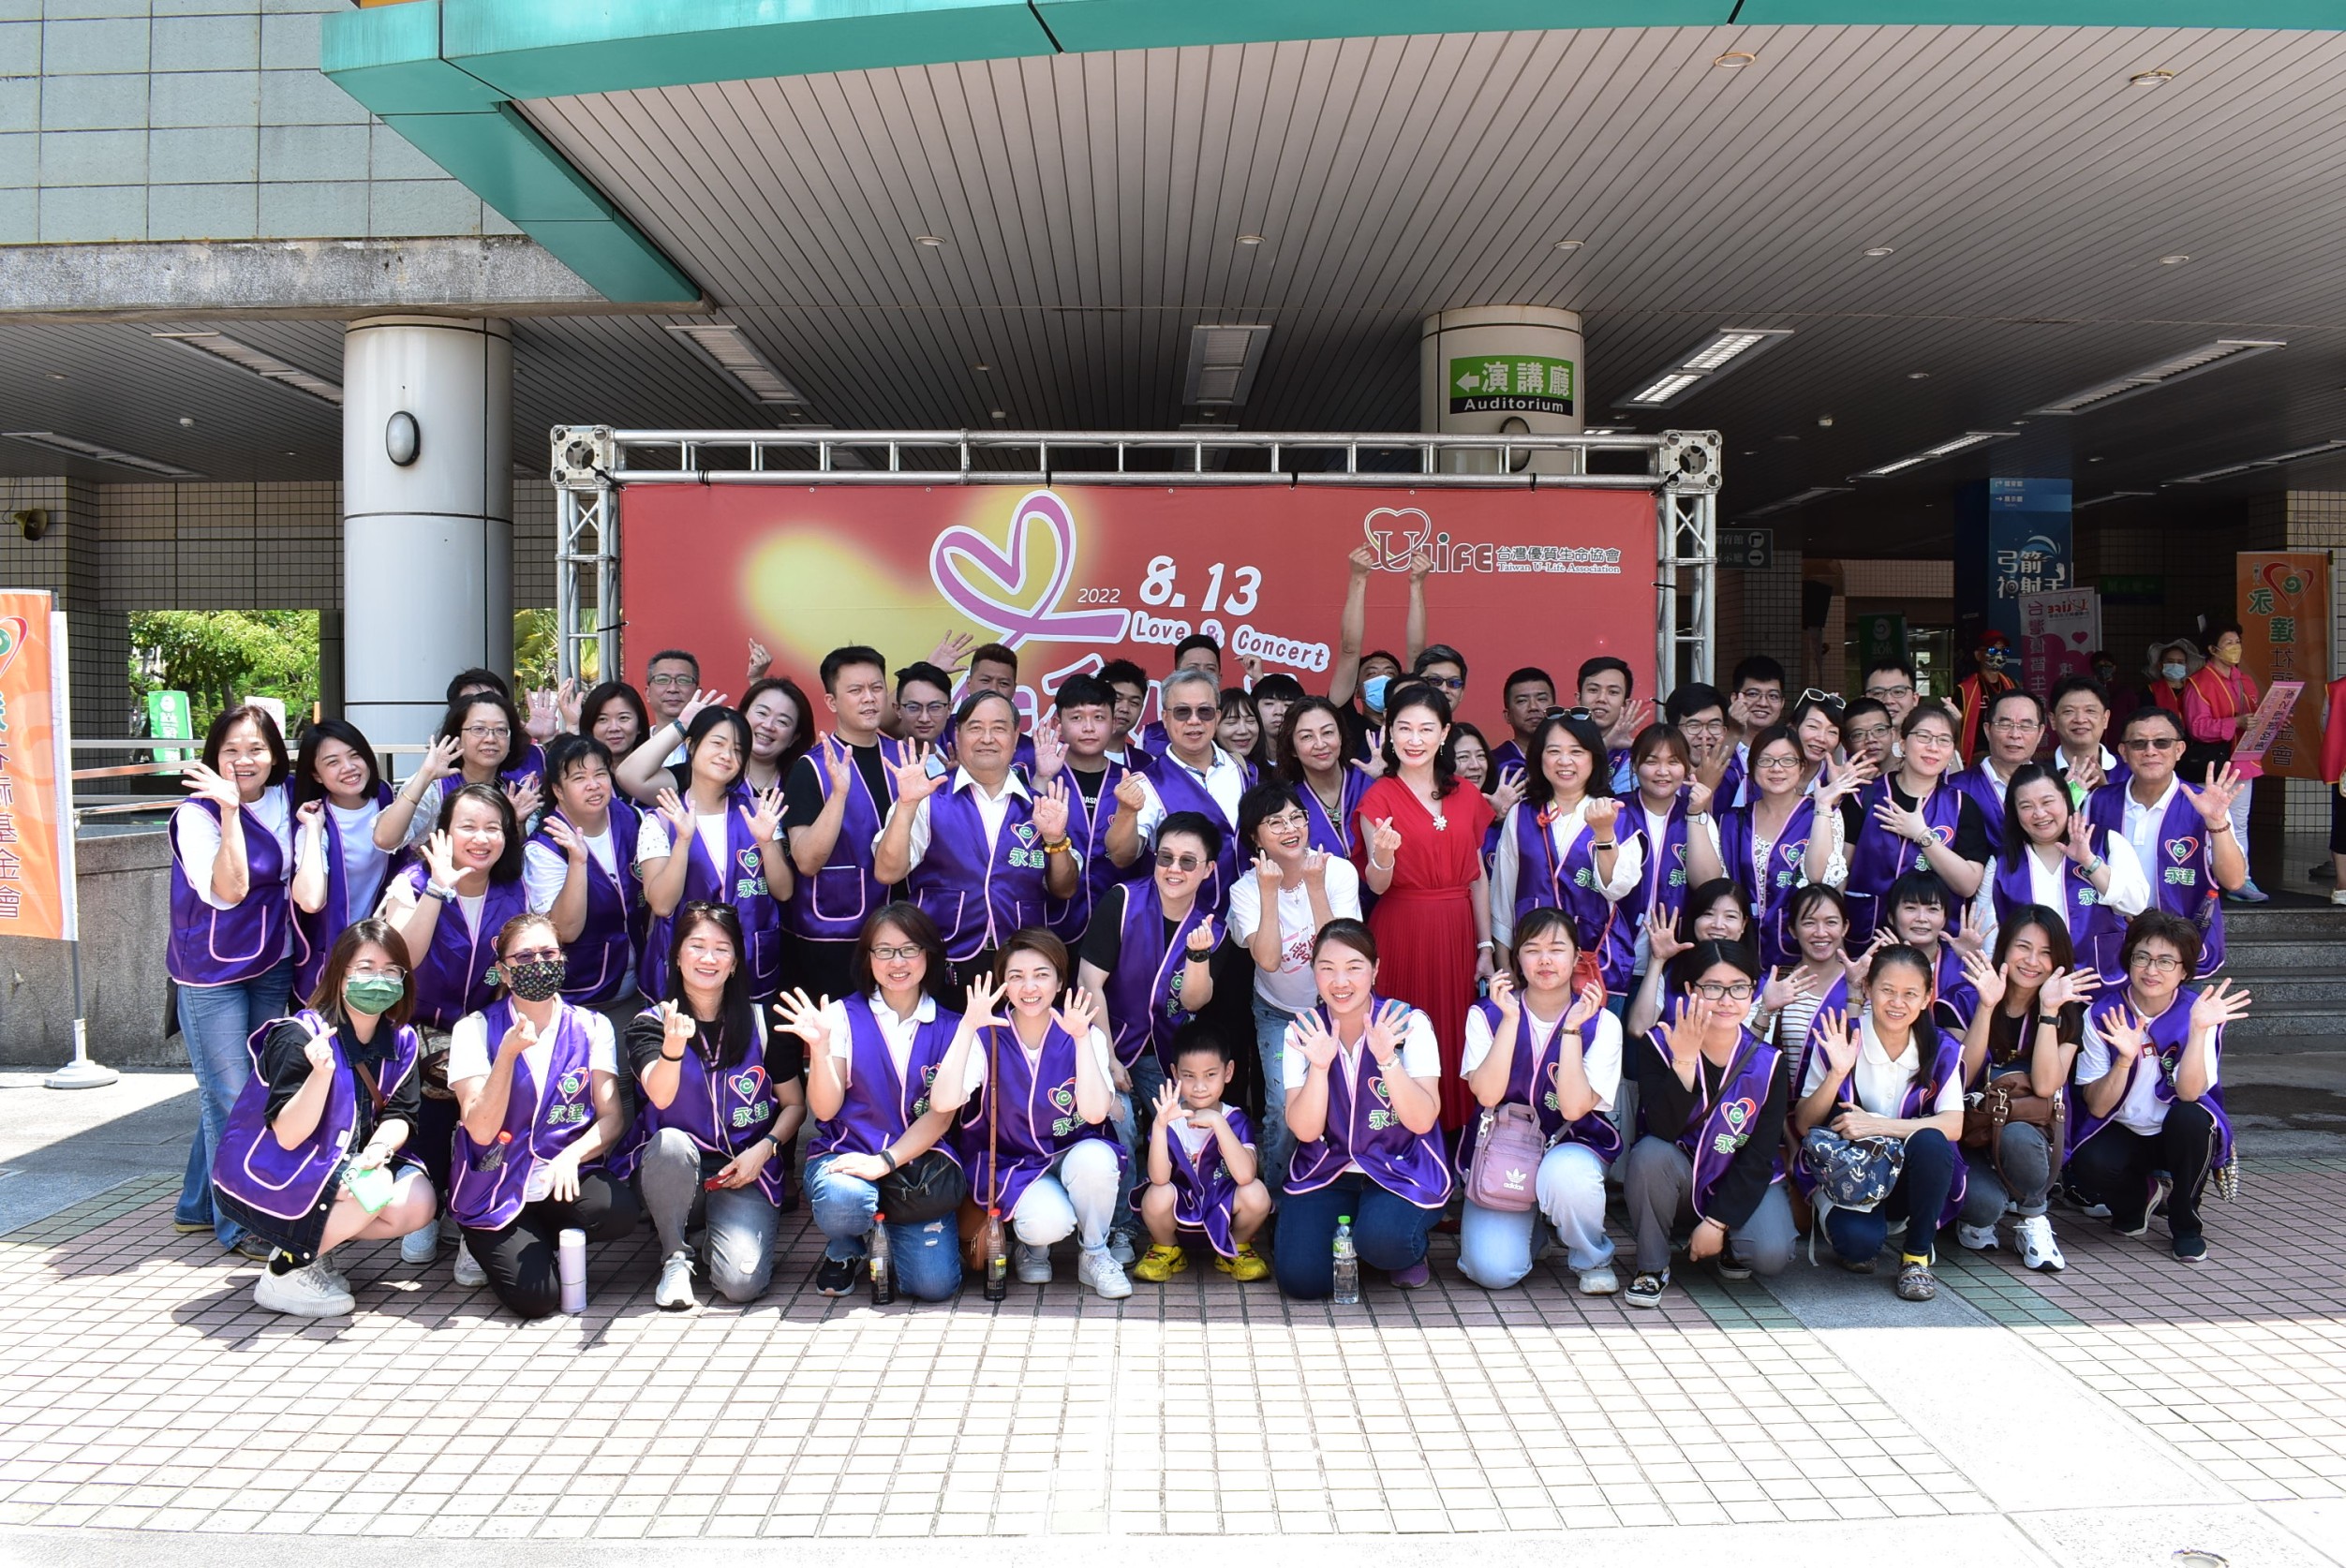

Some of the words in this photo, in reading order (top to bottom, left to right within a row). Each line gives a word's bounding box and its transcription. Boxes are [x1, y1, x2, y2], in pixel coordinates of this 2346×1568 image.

[1481, 362, 1569, 396] 演講廳
[1464, 397, 1564, 413] Auditorium
[1496, 545, 1621, 563] 台灣優質生命協會
[1997, 550, 2043, 573] 弓箭
[1498, 562, 1531, 571] Taiwan
[1532, 562, 1566, 572] U-Life
[1566, 563, 1621, 573] Association
[1077, 588, 1121, 603] 2022
[1135, 614, 1187, 643] Love
[1236, 629, 1326, 669] Concert
[1008, 847, 1046, 868] 永達
[1669, 868, 1686, 887] 永
[2164, 866, 2195, 885] 永達
[2078, 888, 2098, 906] 永
[547, 1103, 585, 1124] 永達
[733, 1101, 769, 1128] 永達
